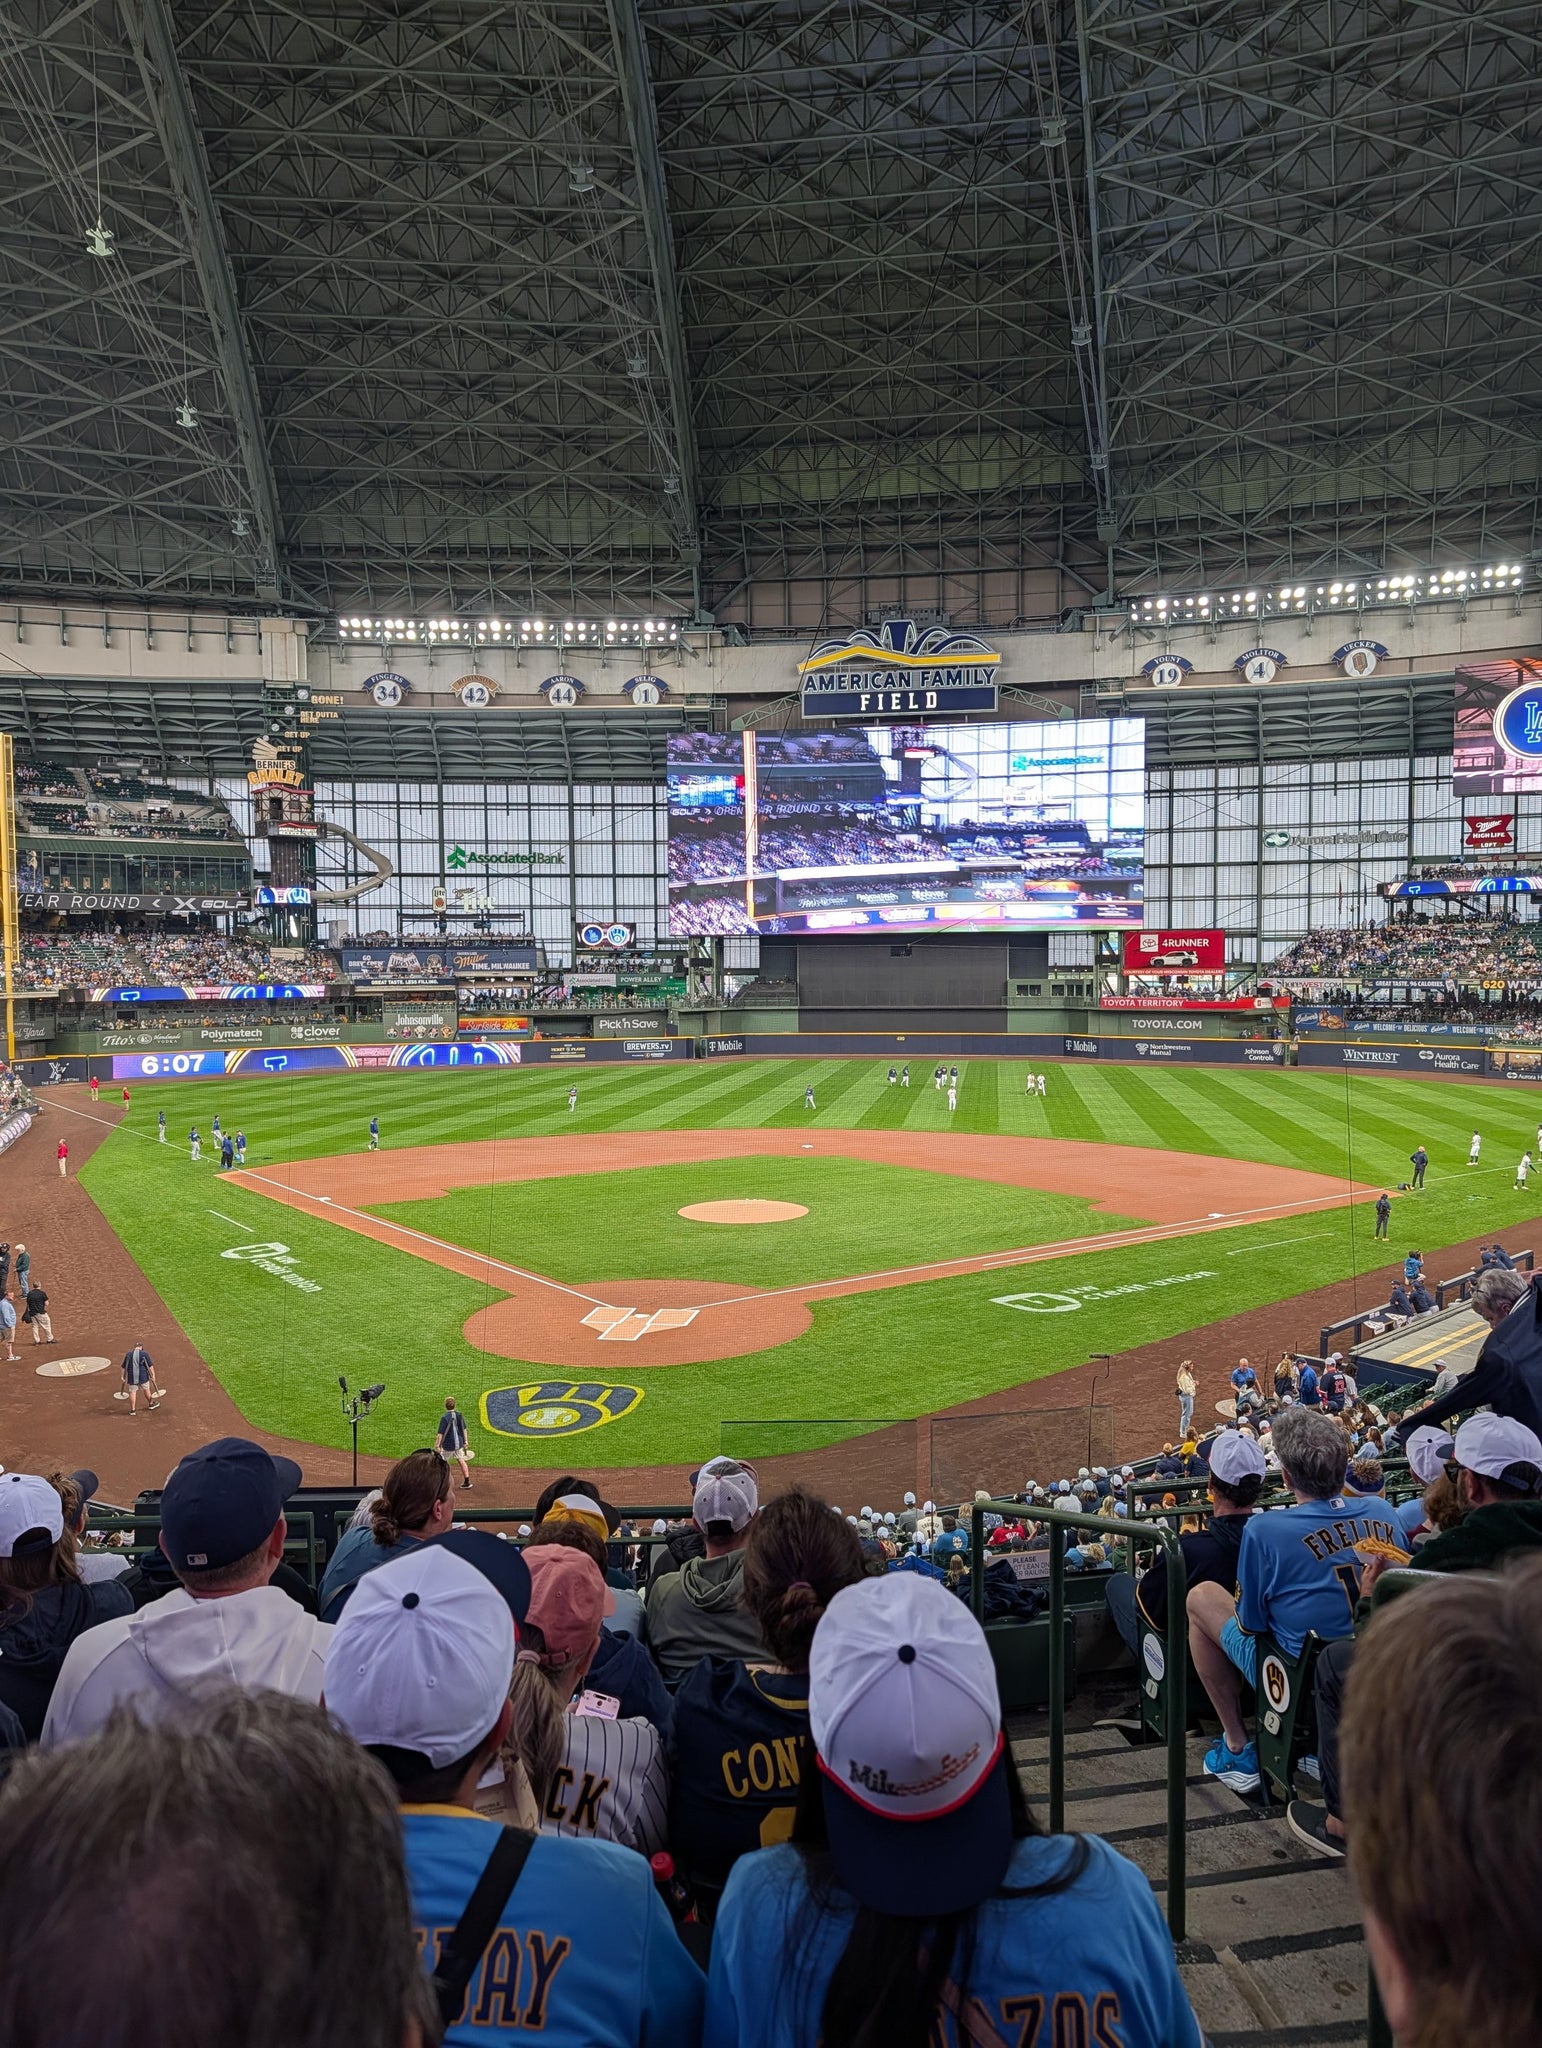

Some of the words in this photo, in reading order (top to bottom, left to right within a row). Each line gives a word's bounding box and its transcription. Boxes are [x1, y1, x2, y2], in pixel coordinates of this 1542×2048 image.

[1343, 640, 1377, 653] UECKER
[1153, 656, 1182, 665] YOUNT
[1241, 649, 1280, 661] MOLITOR
[1253, 662, 1266, 678] 4
[371, 673, 403, 683] FINGERS
[456, 674, 493, 686] ROBINSON
[550, 676, 575, 684] AARON
[804, 671, 912, 692] AMERICAN
[920, 667, 997, 688] FAMILY
[1157, 668, 1179, 685] 19
[376, 686, 399, 701] 34
[464, 687, 487, 704] 42
[552, 688, 574, 704] 44
[641, 689, 652, 704] 1
[311, 695, 344, 705] GONE!
[860, 691, 938, 711] FIELD
[256, 760, 296, 770] BERNIE'S
[247, 768, 305, 787] CHALET
[1476, 819, 1503, 832] Miller
[1293, 834, 1332, 847] Aurora
[1334, 831, 1375, 845] Health
[1376, 830, 1409, 843] Care
[467, 851, 566, 866] AssociatedBank
[71, 896, 140, 909] ROUND
[173, 897, 197, 910] X
[200, 900, 249, 909] GOLF
[463, 893, 496, 914] Lite
[1162, 938, 1210, 948] 4RUNNER
[453, 953, 488, 969] Miller
[472, 962, 490, 970] TIME,
[491, 962, 530, 970] MILWAUKEE
[1482, 980, 1506, 990] 620
[1507, 981, 1542, 990] WTMJ
[1136, 1000, 1184, 1008] TERRITORY
[396, 1014, 444, 1027] Johnsonville
[600, 1018, 622, 1030] Pick
[632, 1019, 659, 1029] Save
[1296, 1012, 1319, 1024] Culver's
[466, 1022, 501, 1032] Surfside
[1132, 1019, 1202, 1030] TOYOTA.COM
[1373, 1023, 1396, 1031] WELCOME
[1404, 1024, 1428, 1032] DELICIOUS
[1452, 1026, 1477, 1034] WELCOME
[23, 1027, 46, 1040] Yard
[200, 1028, 262, 1039] Polymatech
[304, 1026, 341, 1036] clover
[102, 1034, 135, 1047] Tito's
[626, 1042, 670, 1051] BREWERS.TV
[718, 1040, 743, 1052] Mobile
[1073, 1040, 1098, 1054] Mobile
[1244, 1048, 1270, 1056] Johnson
[1248, 1054, 1274, 1062] Controls
[1343, 1049, 1398, 1061] WINTRUST
[1436, 1052, 1461, 1061] Aurora
[14, 1064, 24, 1072] 342
[141, 1054, 205, 1075] 6:07
[1434, 1060, 1460, 1069] Health
[1460, 1062, 1480, 1070] Care
[1148, 1270, 1219, 1287] union
[1302, 1518, 1395, 1561] FRELICK
[1012, 1556, 1037, 1564] PLEASE
[1024, 1562, 1040, 1570] LEAN
[1268, 1717, 1275, 1729] 2
[721, 1735, 804, 1798] CON
